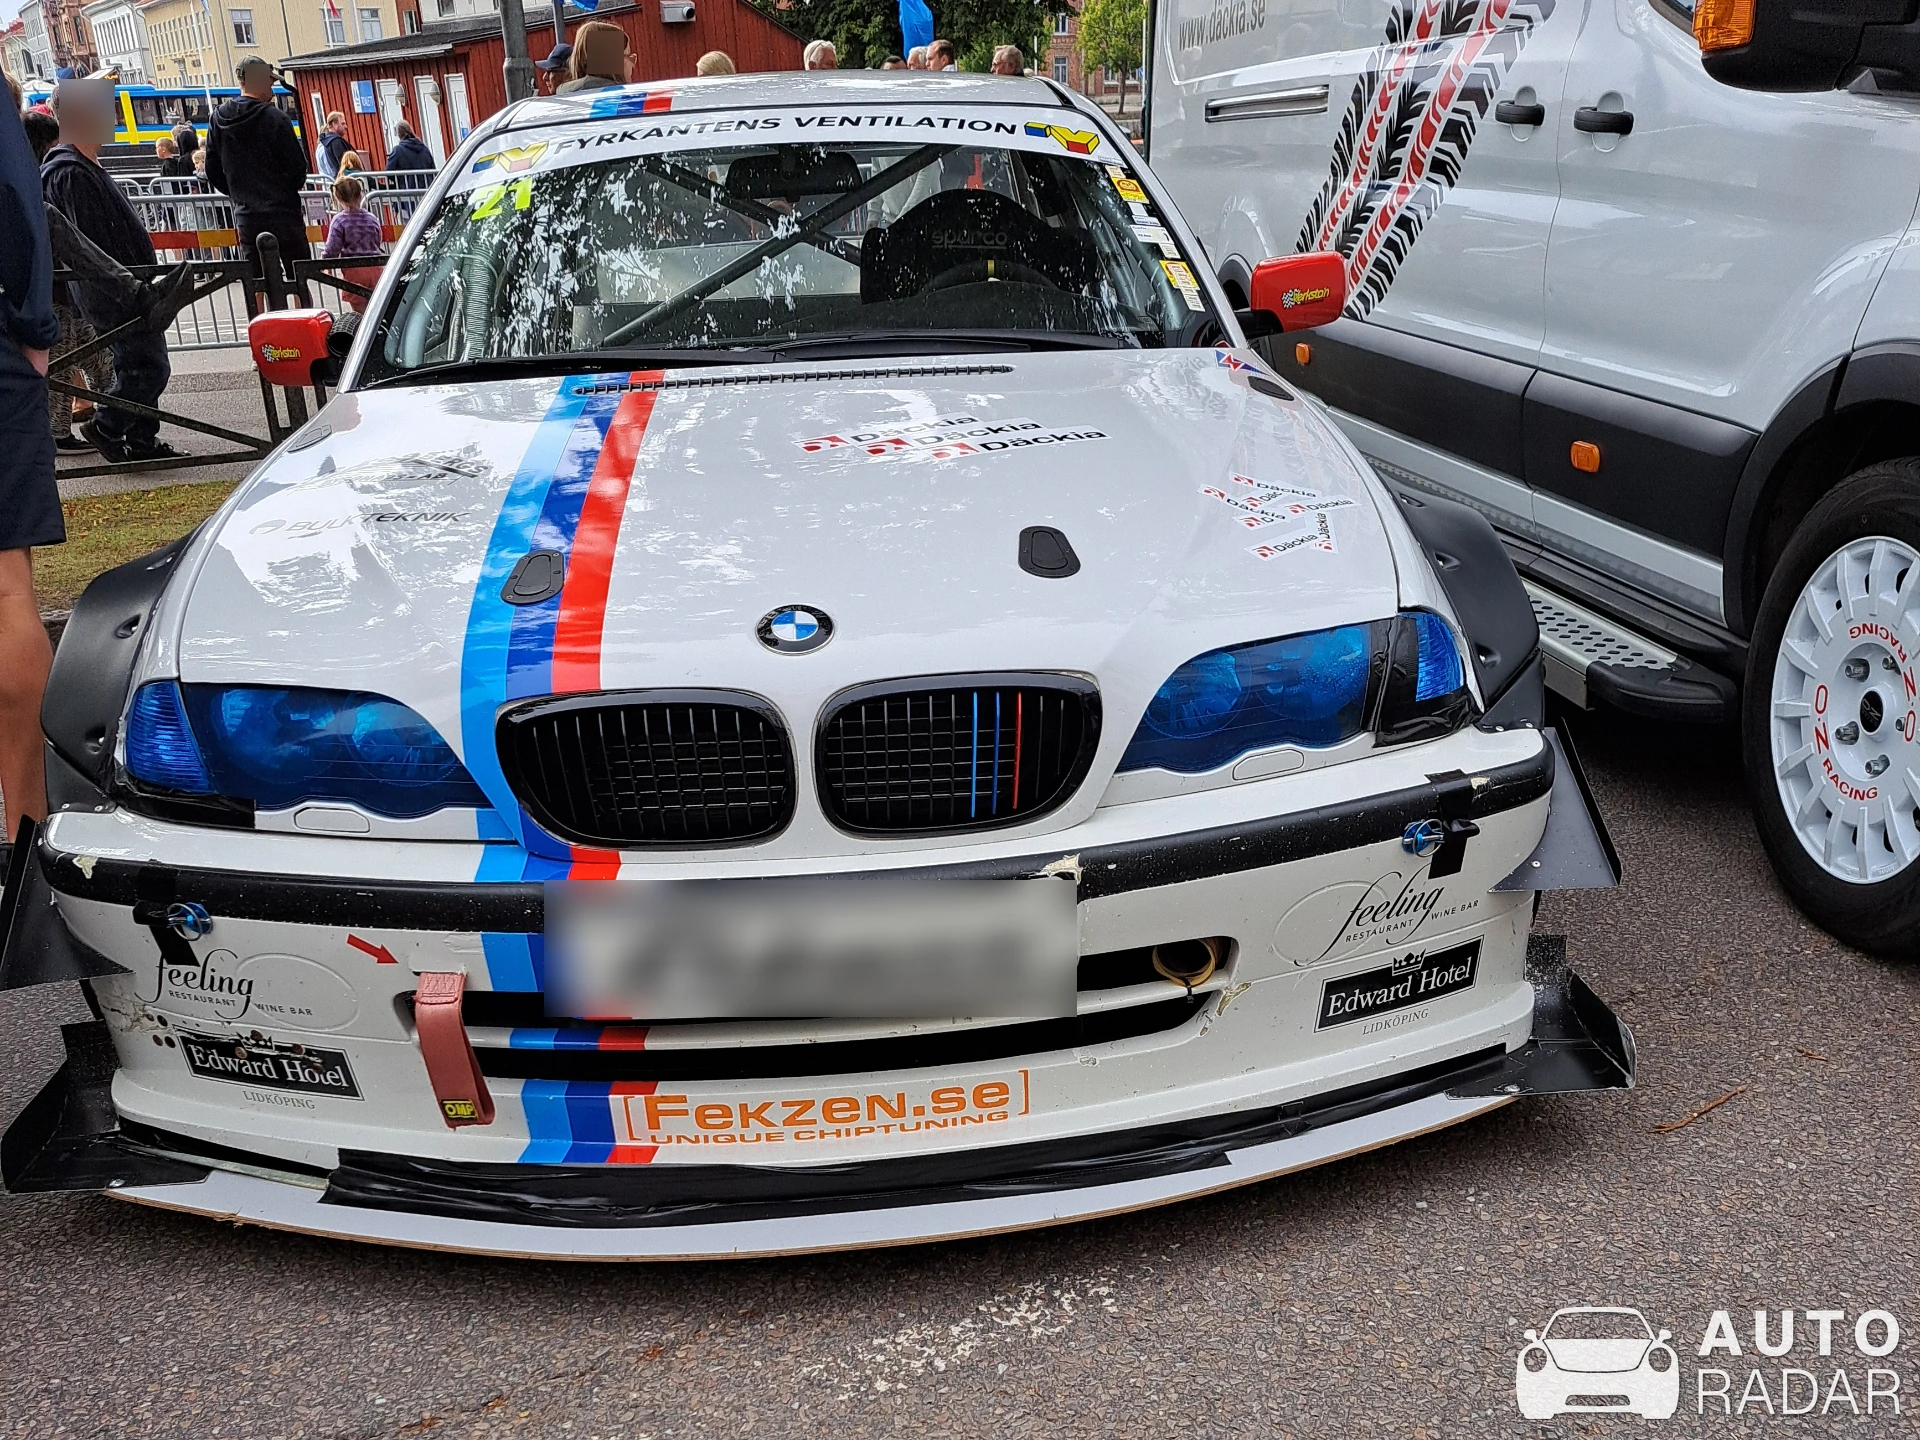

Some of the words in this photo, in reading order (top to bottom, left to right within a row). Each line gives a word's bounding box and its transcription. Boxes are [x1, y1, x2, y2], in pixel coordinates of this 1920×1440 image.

[1179, 0, 1266, 51] www.däckia.se
[553, 117, 781, 155] FYRKANTENS
[794, 115, 1017, 135] VENTILATION
[471, 177, 533, 221] 21
[931, 230, 1007, 249] sparco
[850, 414, 980, 443] Däckia
[912, 420, 1043, 446] Däckia
[979, 429, 1107, 452] Däckia
[1256, 482, 1317, 498] Däckia
[1226, 498, 1286, 520] Däckia
[1306, 499, 1354, 511] Däckia
[1273, 533, 1319, 553] Däckia
[1849, 622, 1907, 663] RACING
[1823, 758, 1878, 801] RACING
[1294, 862, 1445, 967] feeling
[1345, 918, 1414, 943] RESTAURANT
[1430, 907, 1457, 921] WINE
[1460, 899, 1479, 913] BAR
[134, 948, 254, 1020] feeling
[1326, 975, 1412, 1018] Edward
[1418, 957, 1473, 993] Hotel
[168, 989, 237, 1007] RESTAURANT
[253, 1002, 285, 1014] WINE
[290, 1006, 313, 1017] BAR
[1362, 1008, 1430, 1036] LIDKÖPING
[188, 1044, 281, 1080] Edward
[279, 1058, 349, 1088] Hotel
[242, 1090, 316, 1110] LIDKÖPING
[444, 1103, 475, 1116] OMP
[651, 1129, 785, 1145] UNIQUE
[793, 1110, 1010, 1141] CHIPTUNING
